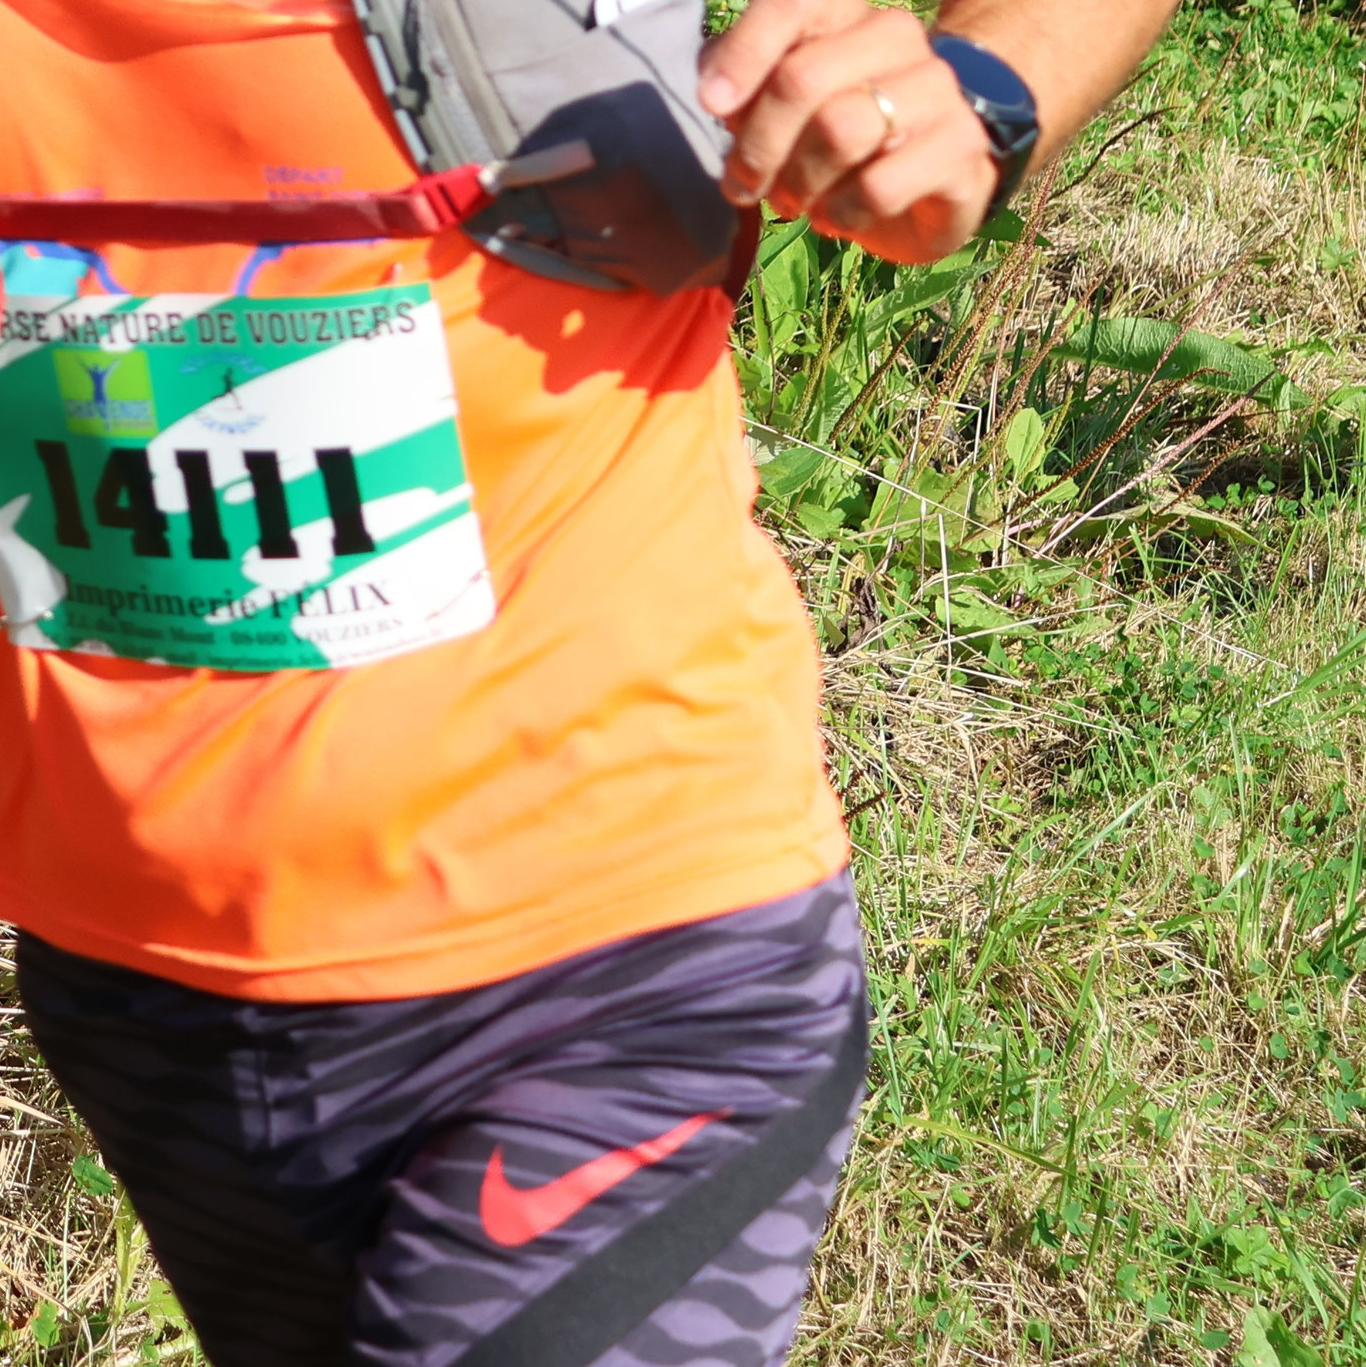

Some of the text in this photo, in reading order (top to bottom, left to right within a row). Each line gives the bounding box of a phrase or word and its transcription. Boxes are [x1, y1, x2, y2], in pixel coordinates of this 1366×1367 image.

[61, 312, 185, 344] NATURE
[197, 312, 236, 344] DE
[246, 301, 416, 344] VOUZIERS
[37, 439, 375, 560] 14111
[65, 573, 393, 619] Imprimerie FÉLIX
